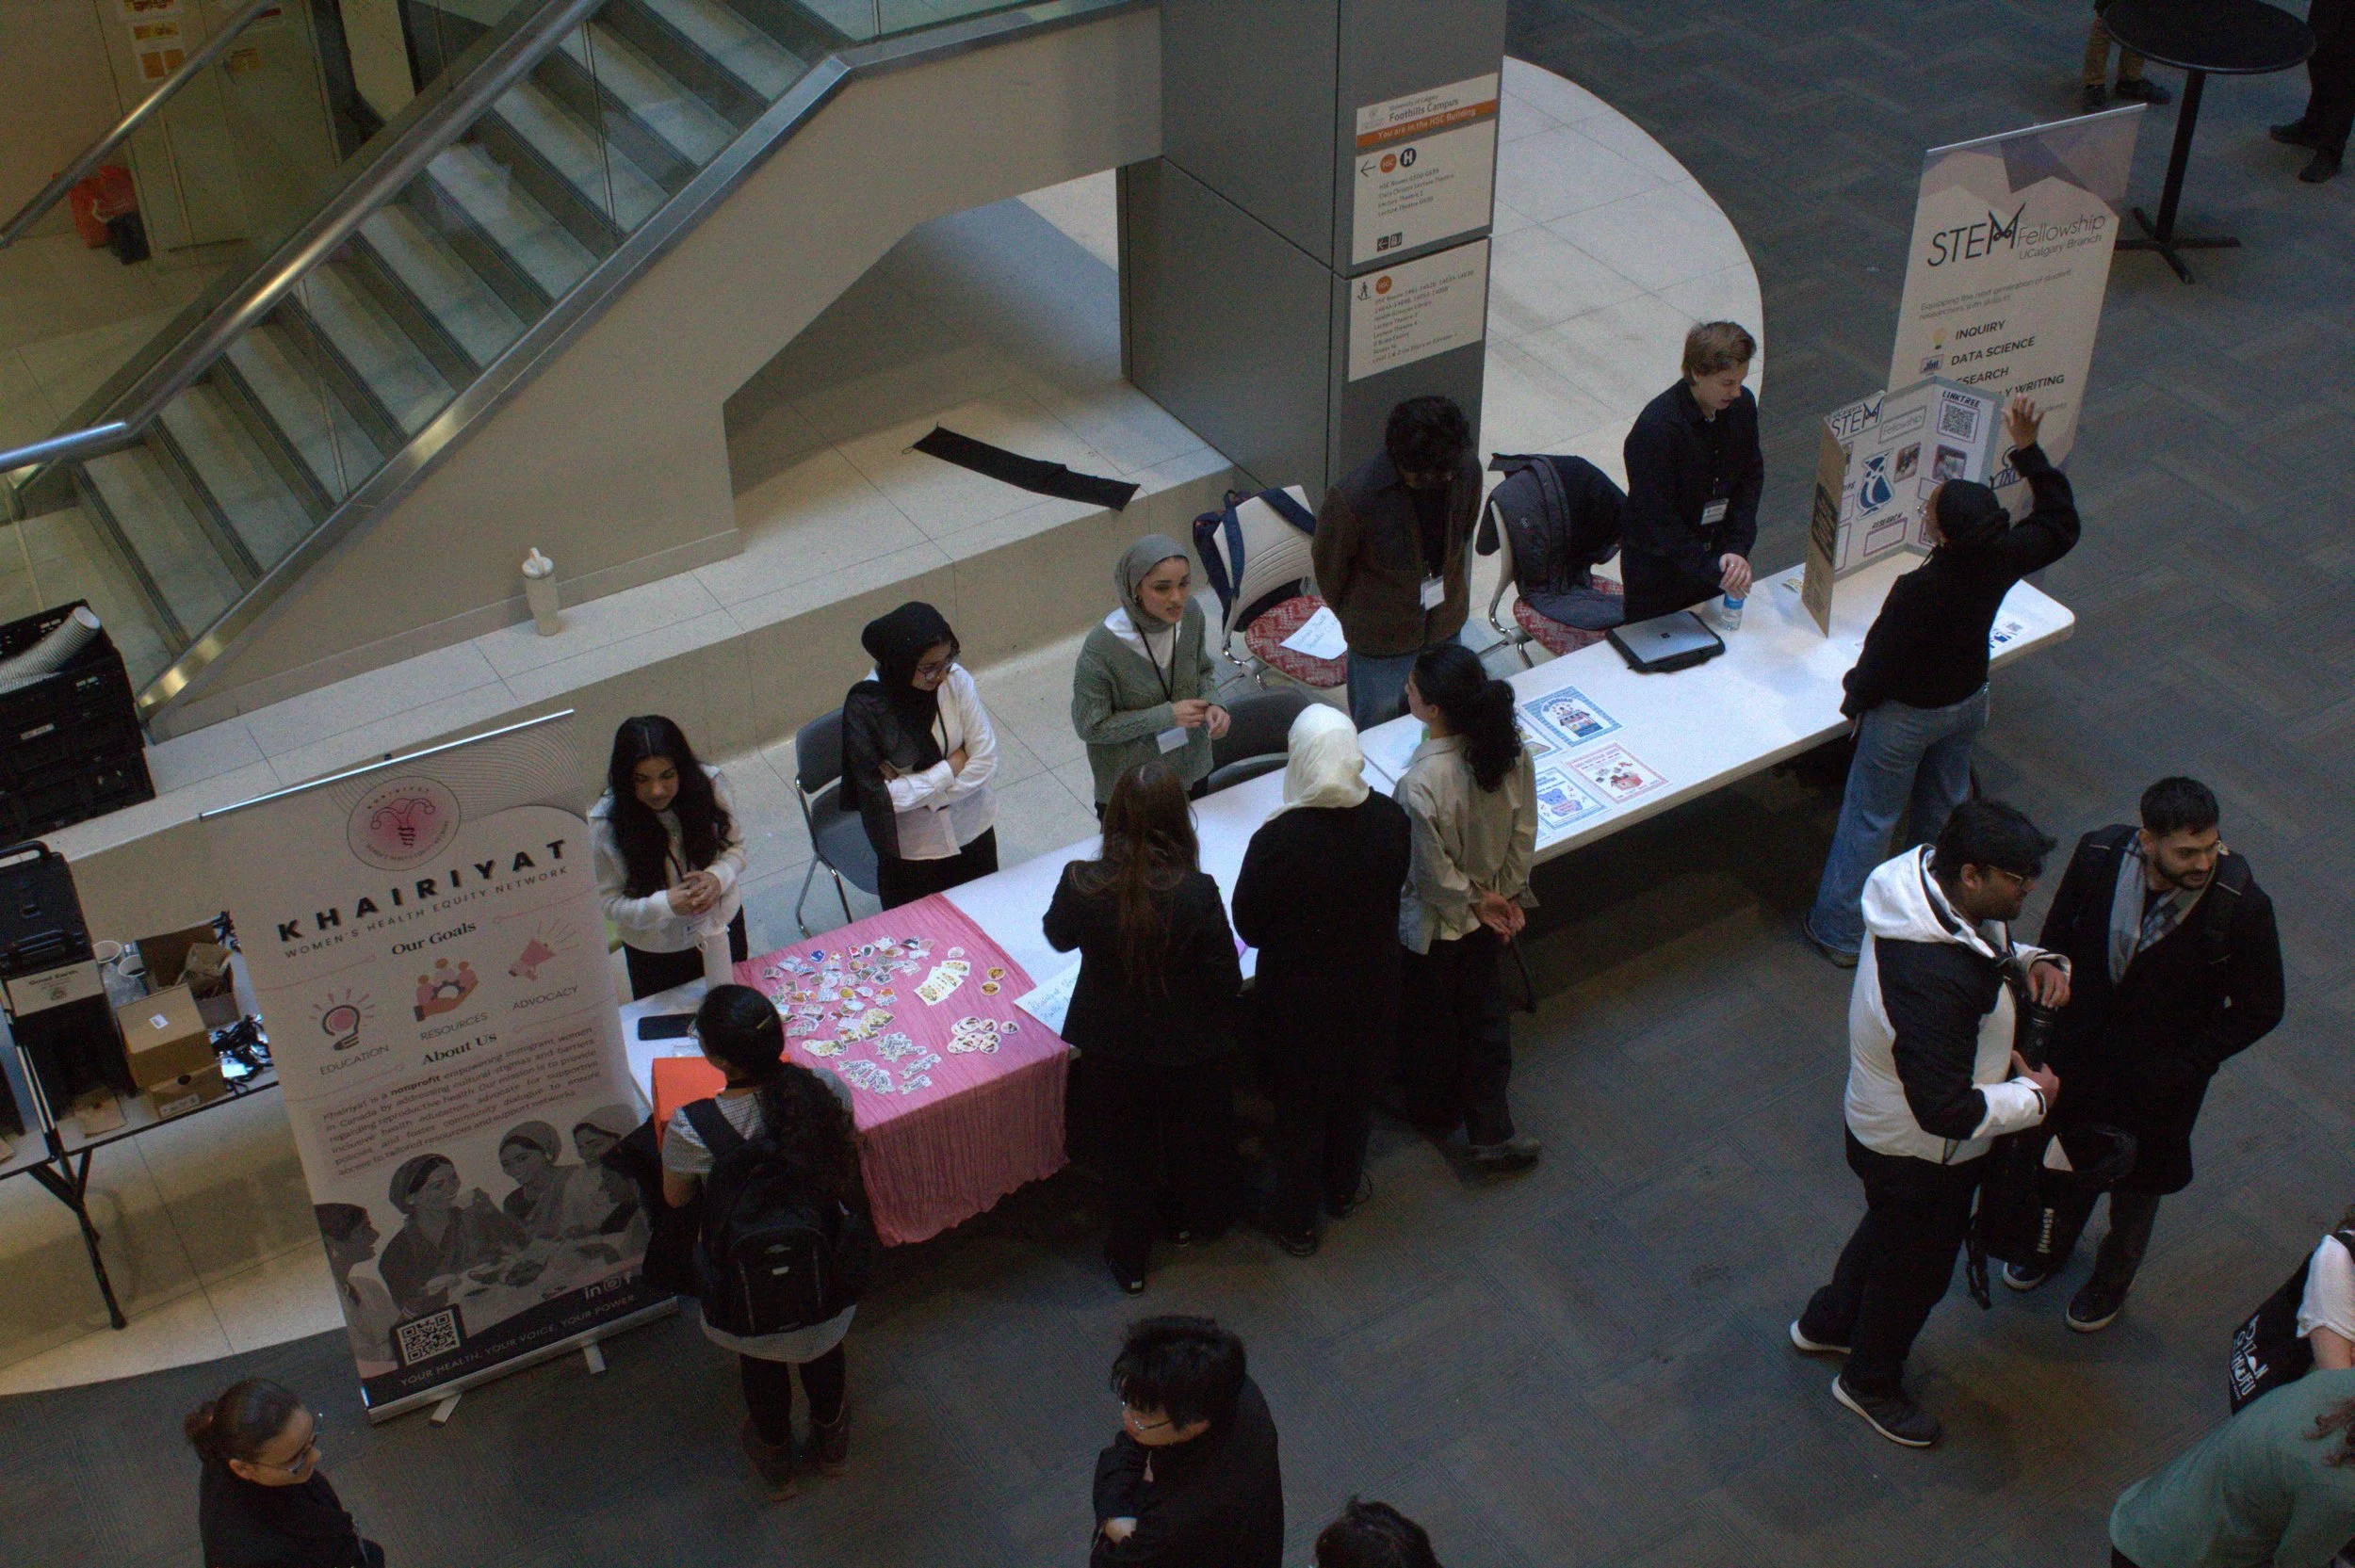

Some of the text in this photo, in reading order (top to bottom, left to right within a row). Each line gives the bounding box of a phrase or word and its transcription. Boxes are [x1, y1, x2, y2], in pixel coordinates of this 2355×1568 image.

[1378, 107, 1476, 140] You are in the HSC Building
[1389, 97, 1459, 122] Foothills Campus
[1403, 150, 1413, 165] H
[1926, 202, 2106, 267] STEM Fellowship
[2019, 233, 2103, 260] UCalgary Branch
[1955, 319, 2006, 341] INQUIRY
[1951, 336, 2037, 366] DATA SCIENCE
[1956, 366, 2009, 386] SEARCH
[2015, 374, 2065, 393] WRITING
[1941, 389, 1981, 408] LINKTREE
[1831, 396, 1885, 437] STEM
[277, 839, 566, 942] KHAIRIYAT
[284, 866, 568, 959] WOMEN'S HEALTH EQUITY NETWORK
[391, 921, 478, 956] Our Goals
[512, 985, 578, 1010] ADVOCACY
[420, 1011, 489, 1042] RESOURCES
[319, 1044, 390, 1075] EDUCATION
[390, 1075, 442, 1096] nonprofit
[444, 1054, 503, 1079] empowering
[505, 1038, 555, 1059] immigrant
[558, 1027, 593, 1042] women
[423, 1032, 498, 1065] About Us
[330, 1121, 377, 1142] regarding
[378, 1100, 442, 1124] reproductive
[478, 1081, 495, 1091] Our
[560, 1049, 596, 1066] provide
[339, 1110, 377, 1127] Canada
[380, 1103, 393, 1112] by
[534, 1049, 554, 1060] and
[382, 1119, 413, 1136] health
[546, 1061, 599, 1080] supportive
[381, 1136, 400, 1148] and
[443, 1105, 497, 1127] community
[550, 1082, 560, 1091] to
[473, 1117, 493, 1128] and
[493, 1103, 530, 1122] support
[399, 1368, 434, 1386] YOUR
[484, 1337, 518, 1355] YOUR
[561, 1309, 593, 1326] YOUR
